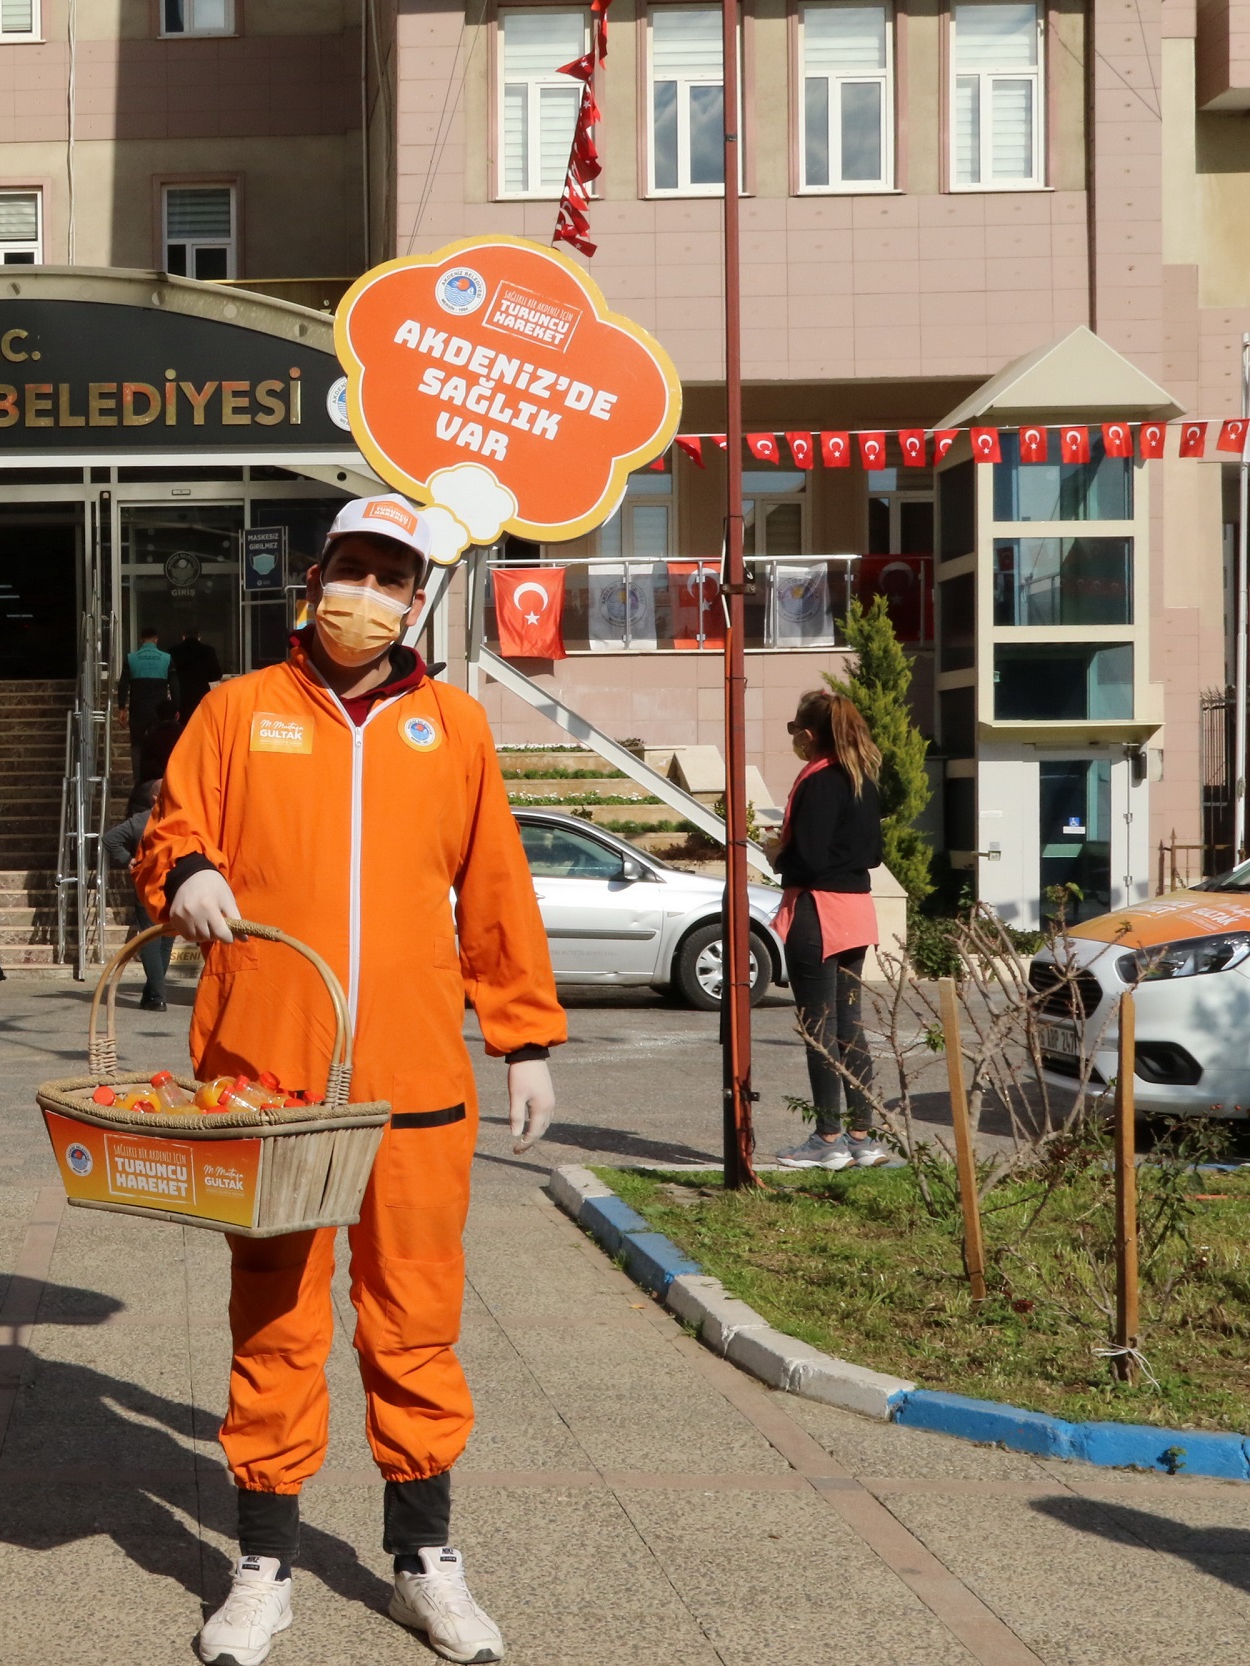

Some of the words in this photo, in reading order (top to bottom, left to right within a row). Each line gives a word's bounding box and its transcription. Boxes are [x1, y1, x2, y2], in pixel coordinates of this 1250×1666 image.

[492, 311, 565, 345] HAREKET
[500, 299, 570, 334] TURUNCU
[393, 319, 618, 421] AKDENİZ'DE
[417, 367, 563, 441] SAĞLIK
[435, 411, 510, 462] VAR
[114, 1157, 188, 1181] TURUNCU
[115, 1172, 188, 1197] HAREKET
